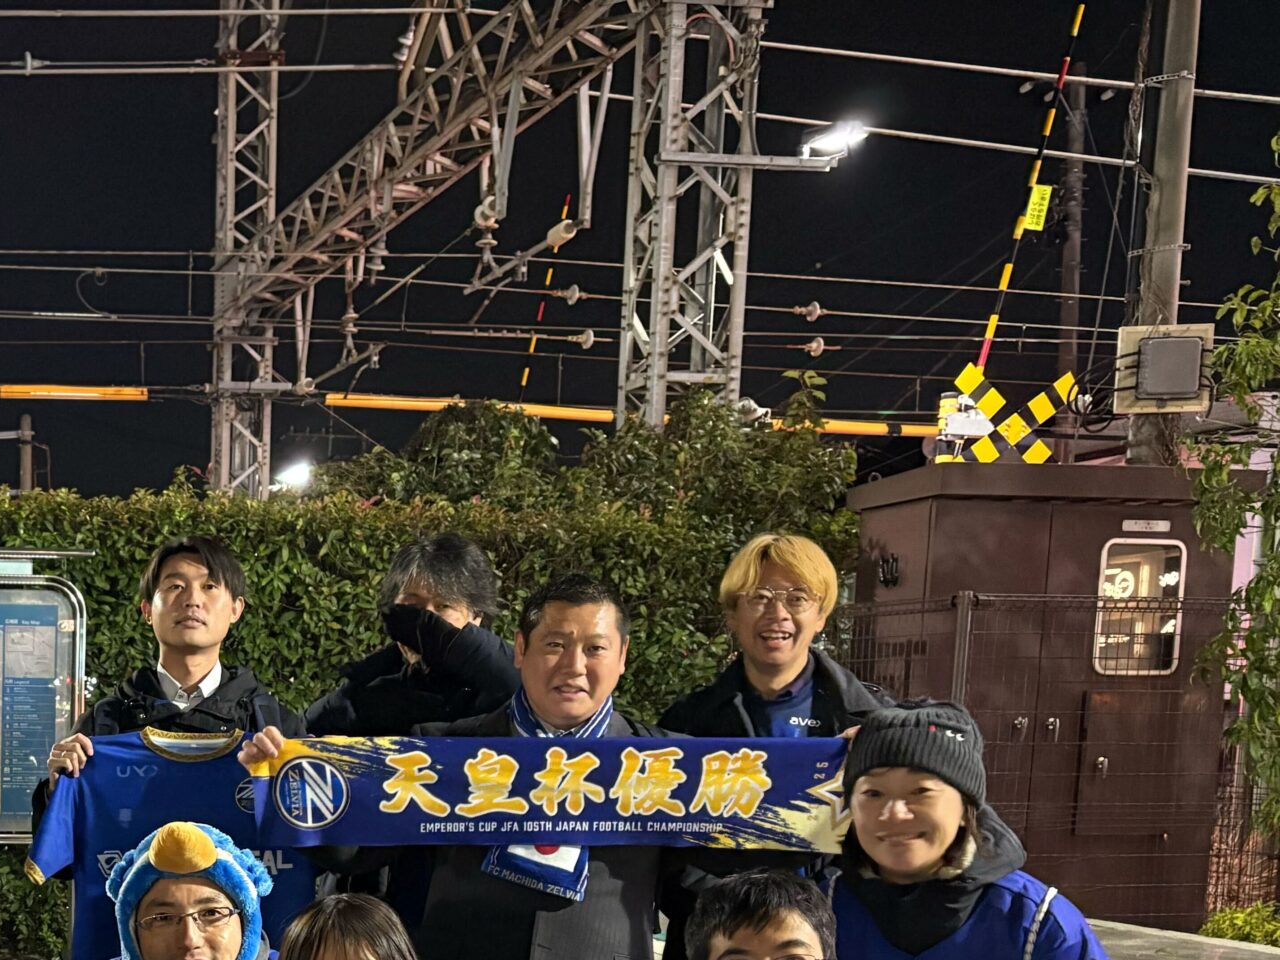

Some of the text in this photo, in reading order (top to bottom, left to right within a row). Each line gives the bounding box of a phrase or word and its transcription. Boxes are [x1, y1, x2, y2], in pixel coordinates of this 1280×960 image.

[288, 768, 301, 817] ZELVIA
[378, 746, 773, 819] 天皇杯優勝
[420, 821, 724, 834] EMPEROR'S CUP JFA 105TH JAPAN FOOTBALL CHAMPIONSHIP
[487, 864, 581, 902] FC MACHIDA ZELVIA
